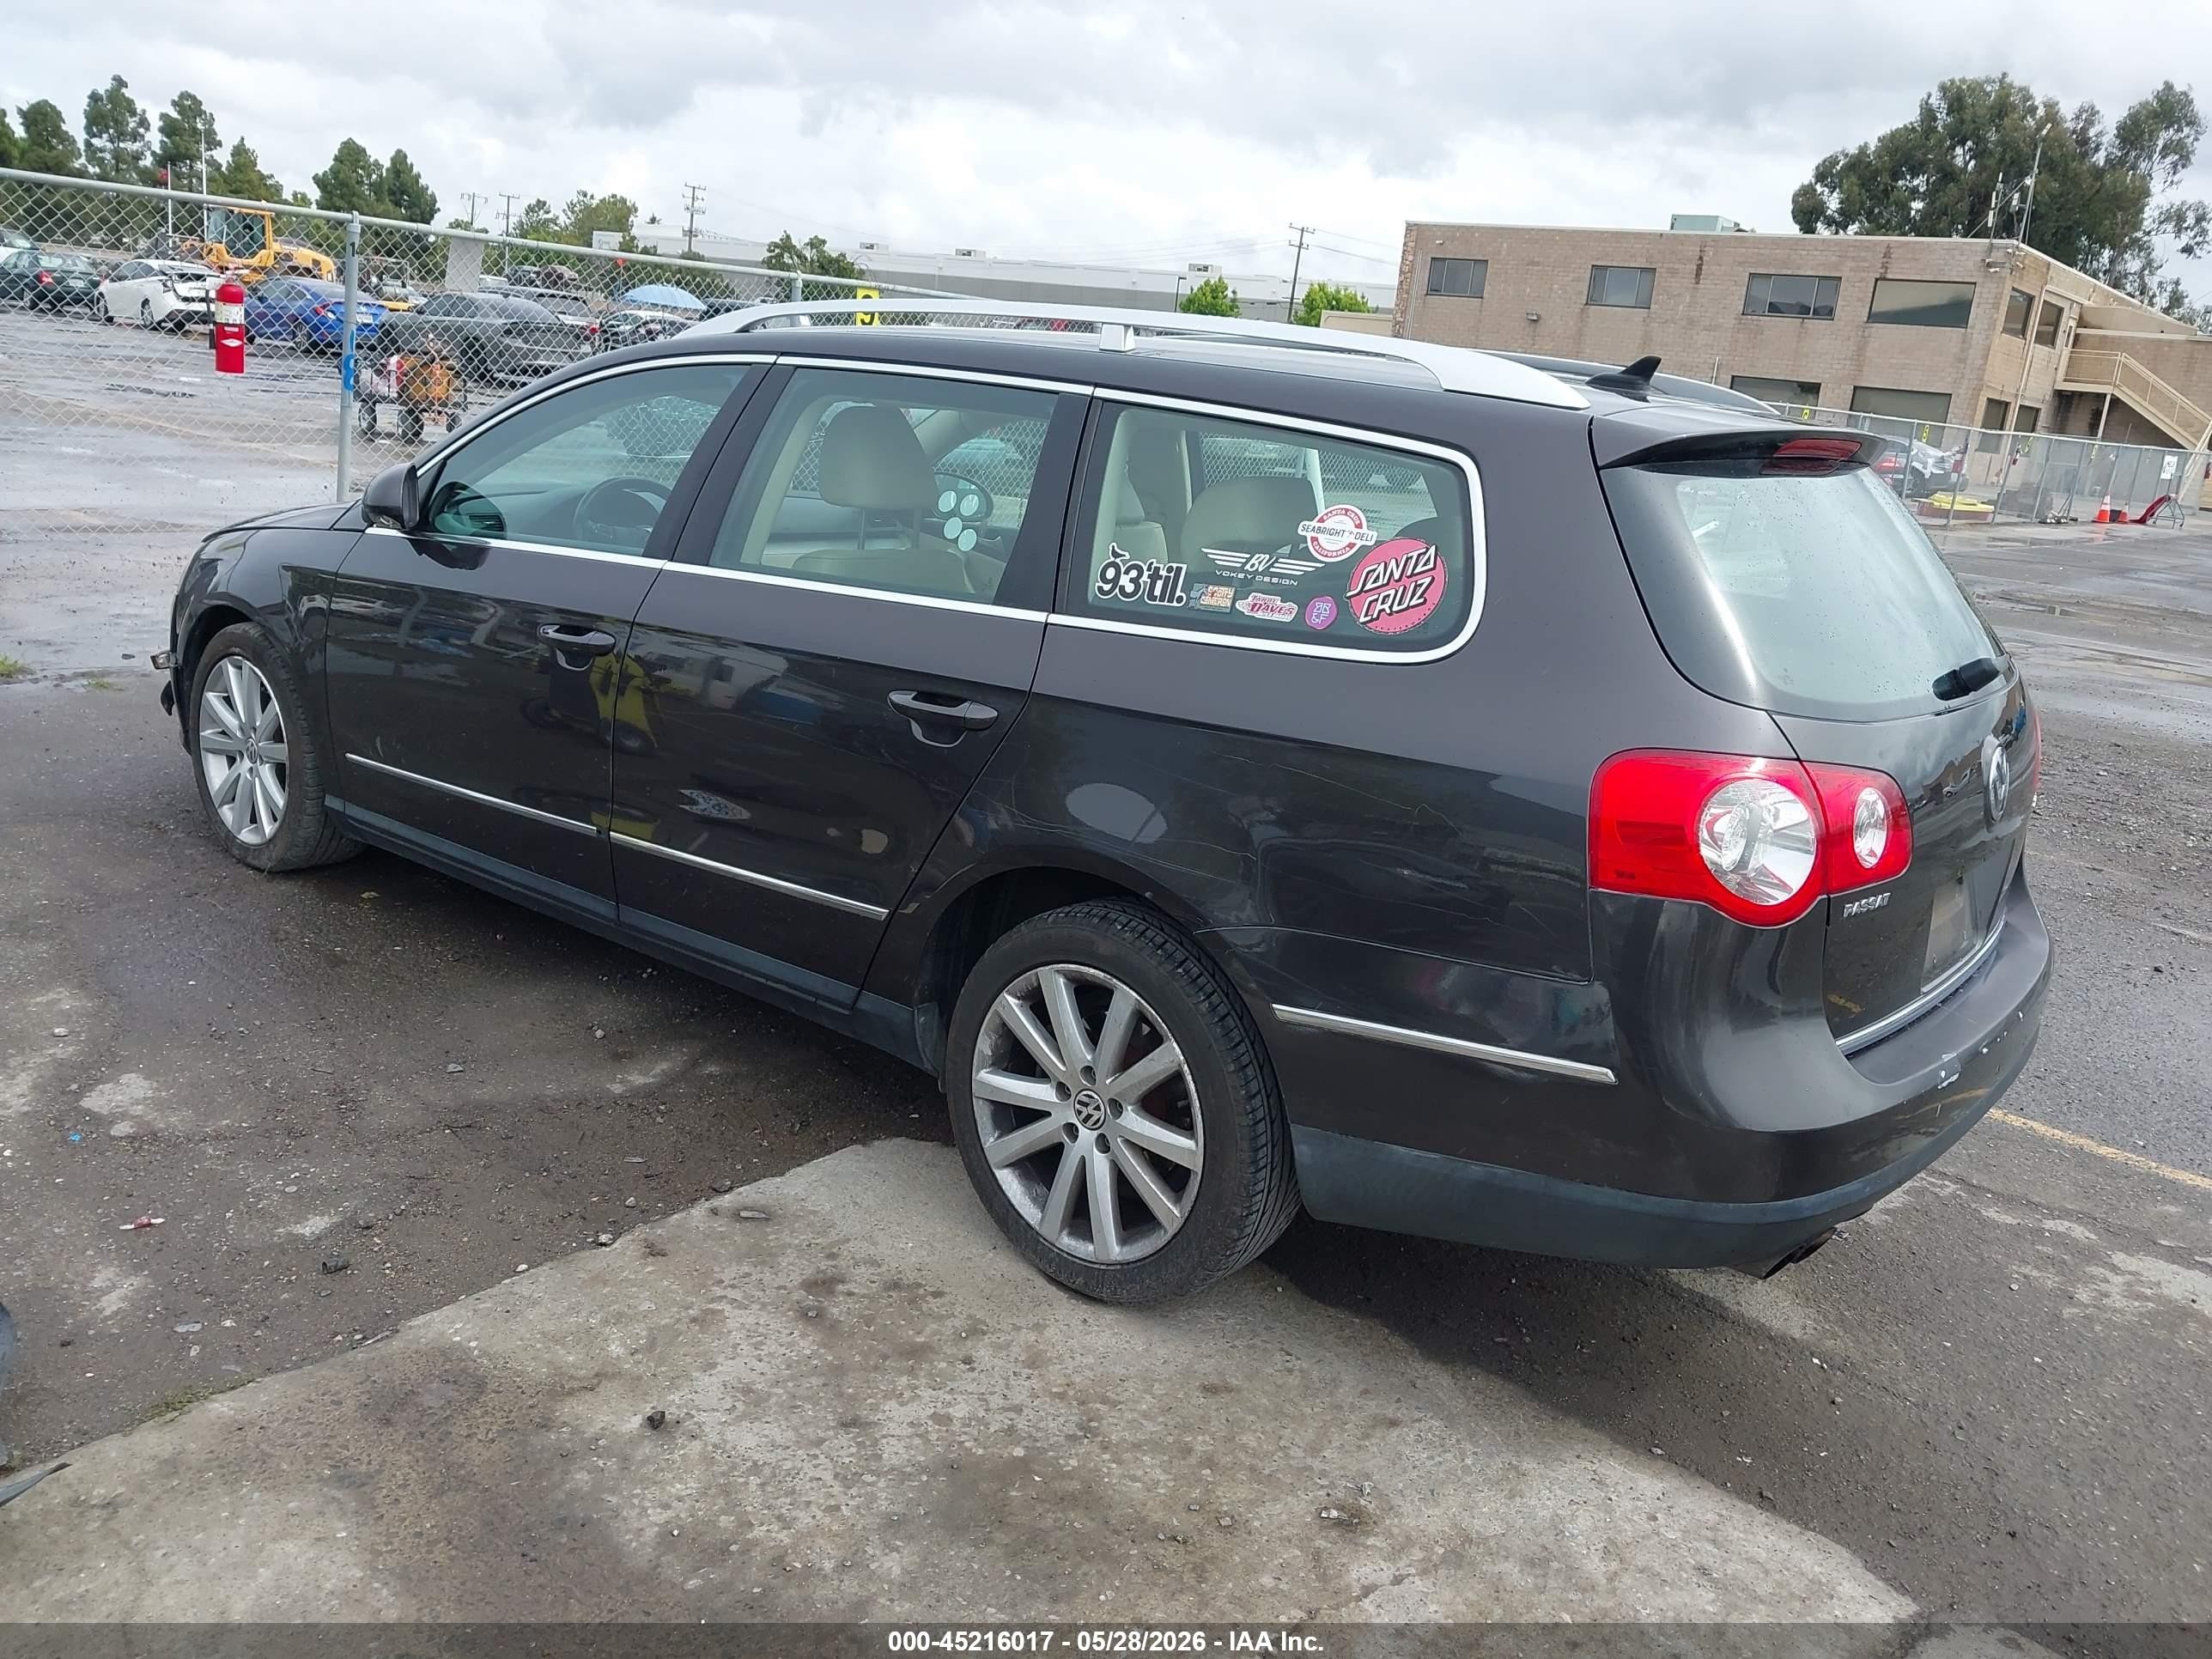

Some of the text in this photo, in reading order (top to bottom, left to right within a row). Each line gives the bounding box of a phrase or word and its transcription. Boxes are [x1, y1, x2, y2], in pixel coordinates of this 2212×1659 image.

[1300, 523, 1374, 542] SEABRIGHT DELI
[1312, 541, 1352, 557] CALIFORNIA
[1215, 569, 1298, 586] VOKEY DESIGN
[1346, 544, 1437, 598] SANTA
[1358, 576, 1435, 624] CRUZ
[1843, 892, 1892, 918] PASSAT
